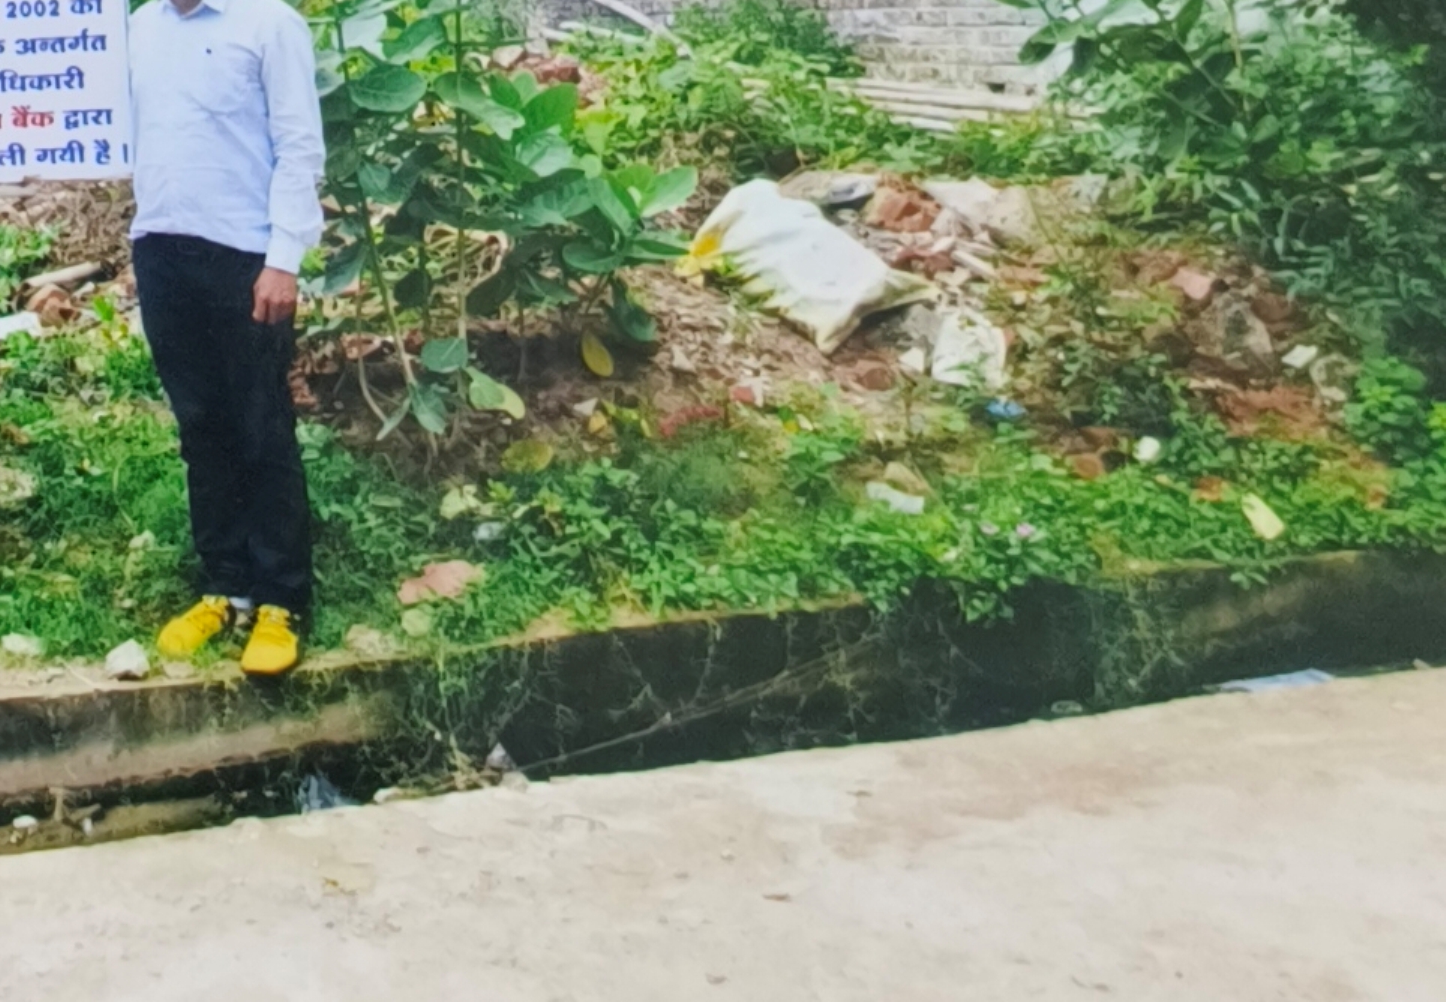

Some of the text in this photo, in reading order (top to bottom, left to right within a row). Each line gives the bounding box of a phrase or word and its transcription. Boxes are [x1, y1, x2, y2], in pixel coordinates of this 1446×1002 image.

[7, 0, 59, 18] 2002
[15, 28, 106, 55] अन्तर्गत
[13, 106, 54, 128] बैंक
[65, 109, 112, 130] द्वारा
[37, 140, 84, 164] गयी
[94, 139, 110, 164] है
